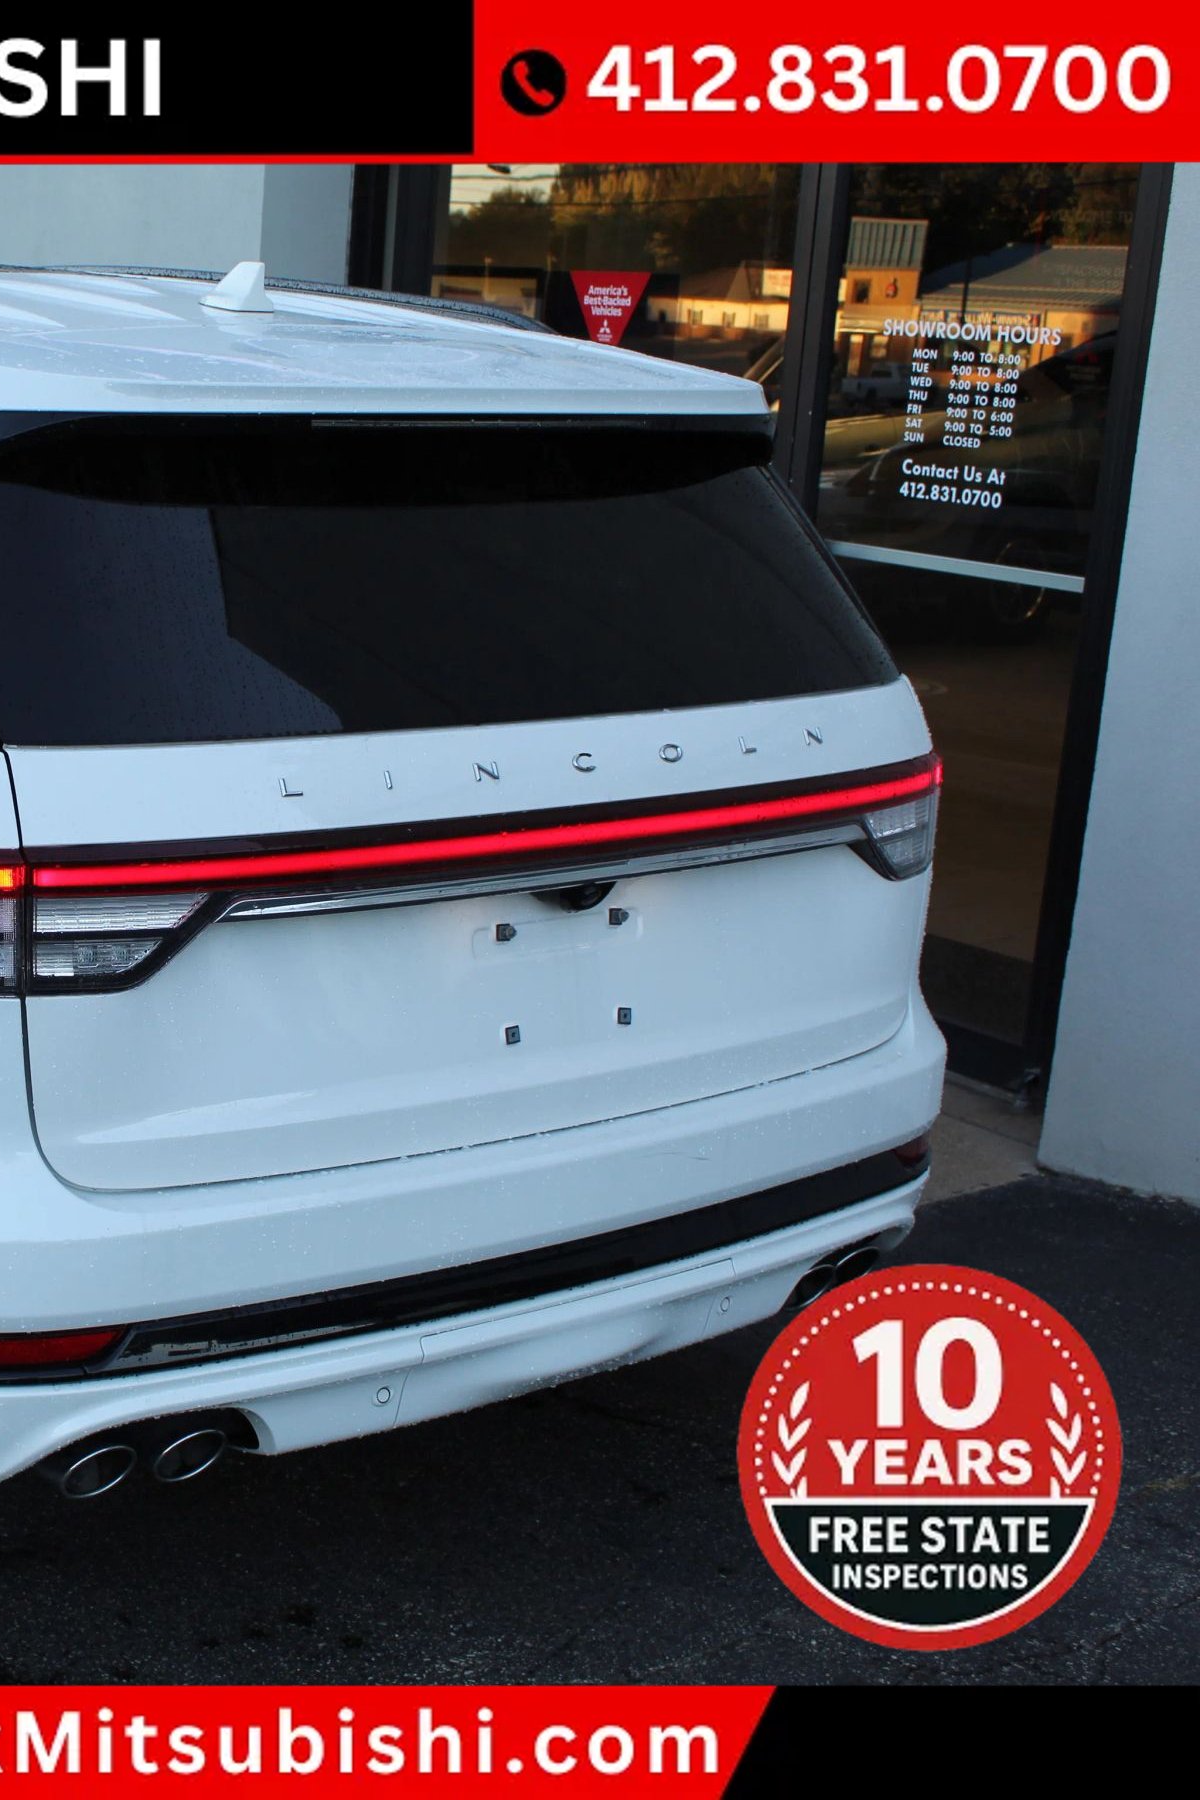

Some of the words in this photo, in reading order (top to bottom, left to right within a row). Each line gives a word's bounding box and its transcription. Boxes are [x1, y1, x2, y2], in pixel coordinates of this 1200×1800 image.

[588, 285, 628, 296] America's
[583, 295, 631, 306] Best-Backed
[591, 306, 622, 316] Vehicles
[882, 318, 992, 342] SHOWROOM
[997, 326, 1062, 346] HOURS
[913, 349, 938, 359] MON
[953, 351, 974, 362] 9:00
[980, 353, 993, 363] TO
[998, 354, 1021, 365] 8:00
[912, 363, 929, 373] TUE
[951, 365, 972, 376] 9:00
[977, 367, 990, 377] TO
[997, 368, 1019, 379] 8:00
[910, 377, 932, 387] WED
[950, 380, 970, 390] 9:00
[976, 381, 989, 391] TO
[994, 383, 1017, 394] 8:00
[909, 390, 928, 401] THU
[948, 394, 969, 405] 9:00
[974, 395, 988, 406] TO
[993, 397, 1016, 409] 8:00
[907, 404, 922, 414] FRI
[946, 408, 967, 419] 9:00
[972, 410, 985, 420] TO
[991, 412, 1013, 423] 6:00
[905, 418, 922, 428] SAT
[944, 422, 965, 433] 9:00
[970, 424, 982, 435] TO
[989, 426, 1012, 437] 5:00
[904, 432, 924, 443] SUN
[943, 436, 980, 448] CLOSED
[902, 458, 958, 480] Contact
[964, 465, 982, 482] Us
[987, 468, 1006, 486] At
[900, 482, 1002, 508] 412.831.0700
[277, 726, 823, 799] LINCOLN
